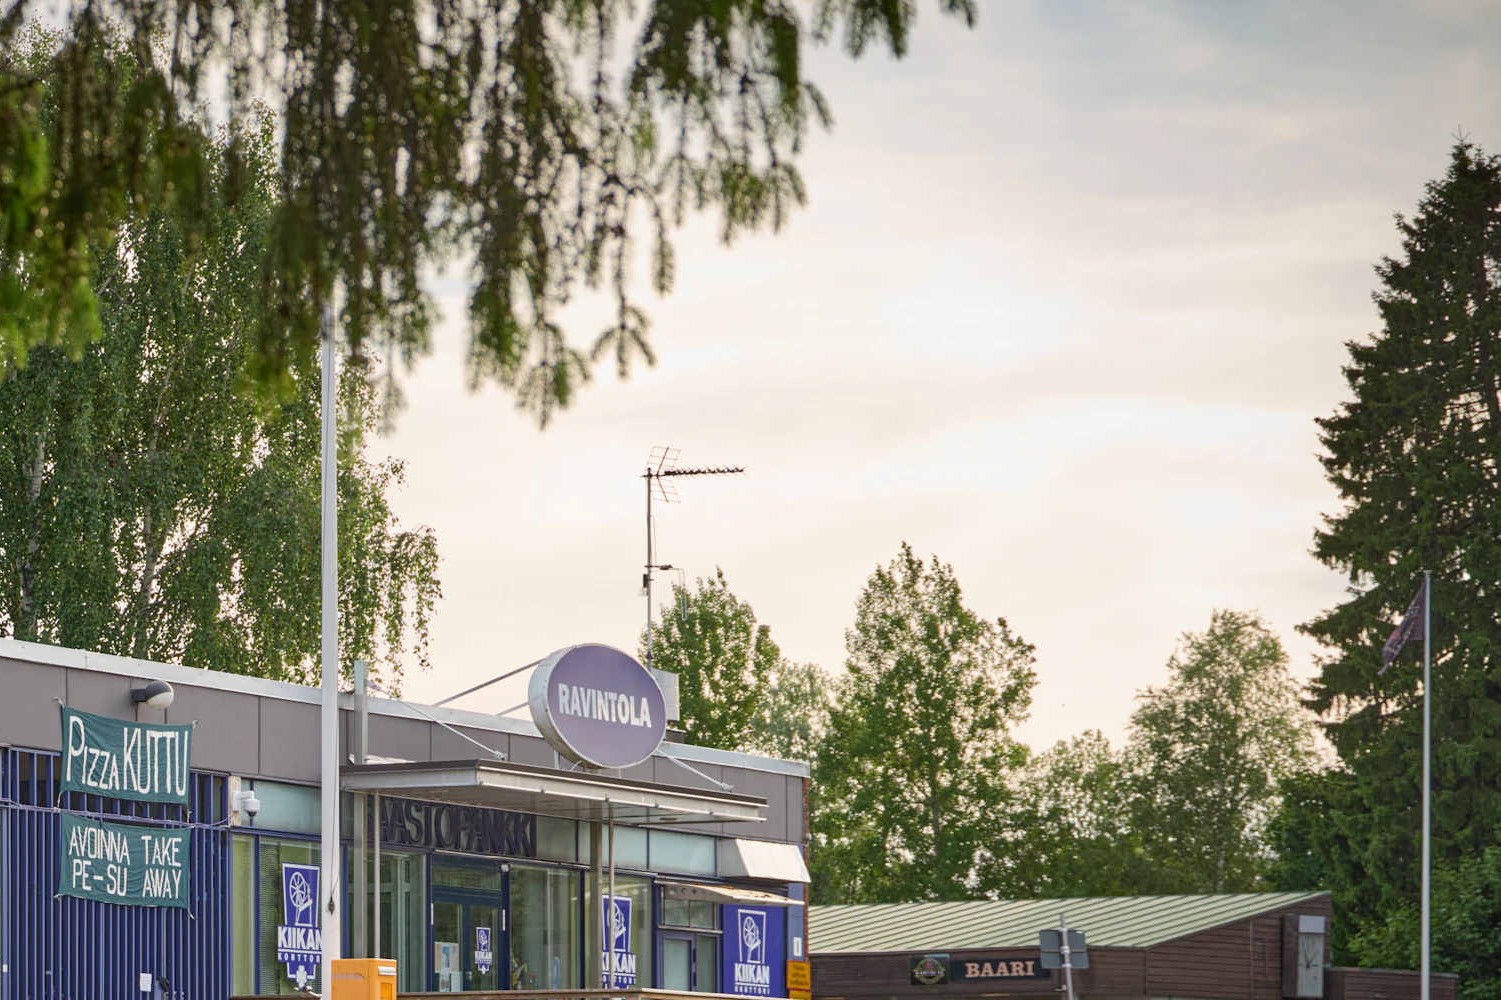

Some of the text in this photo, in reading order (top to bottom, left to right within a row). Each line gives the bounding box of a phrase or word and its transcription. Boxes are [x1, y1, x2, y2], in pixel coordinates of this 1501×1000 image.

[558, 683, 652, 728] RAVINTOLA
[123, 727, 188, 796] KUTTU
[68, 825, 130, 865] AVOINNA
[141, 835, 182, 867] TAKE
[142, 868, 182, 899] AWAY
[278, 926, 322, 951] KIIKAN
[278, 952, 321, 962] KONTTOR
[602, 952, 636, 974] KIKAN
[965, 961, 1035, 978] BAARI
[735, 963, 770, 984] KIIKAN
[735, 985, 770, 995] KONTTORI
